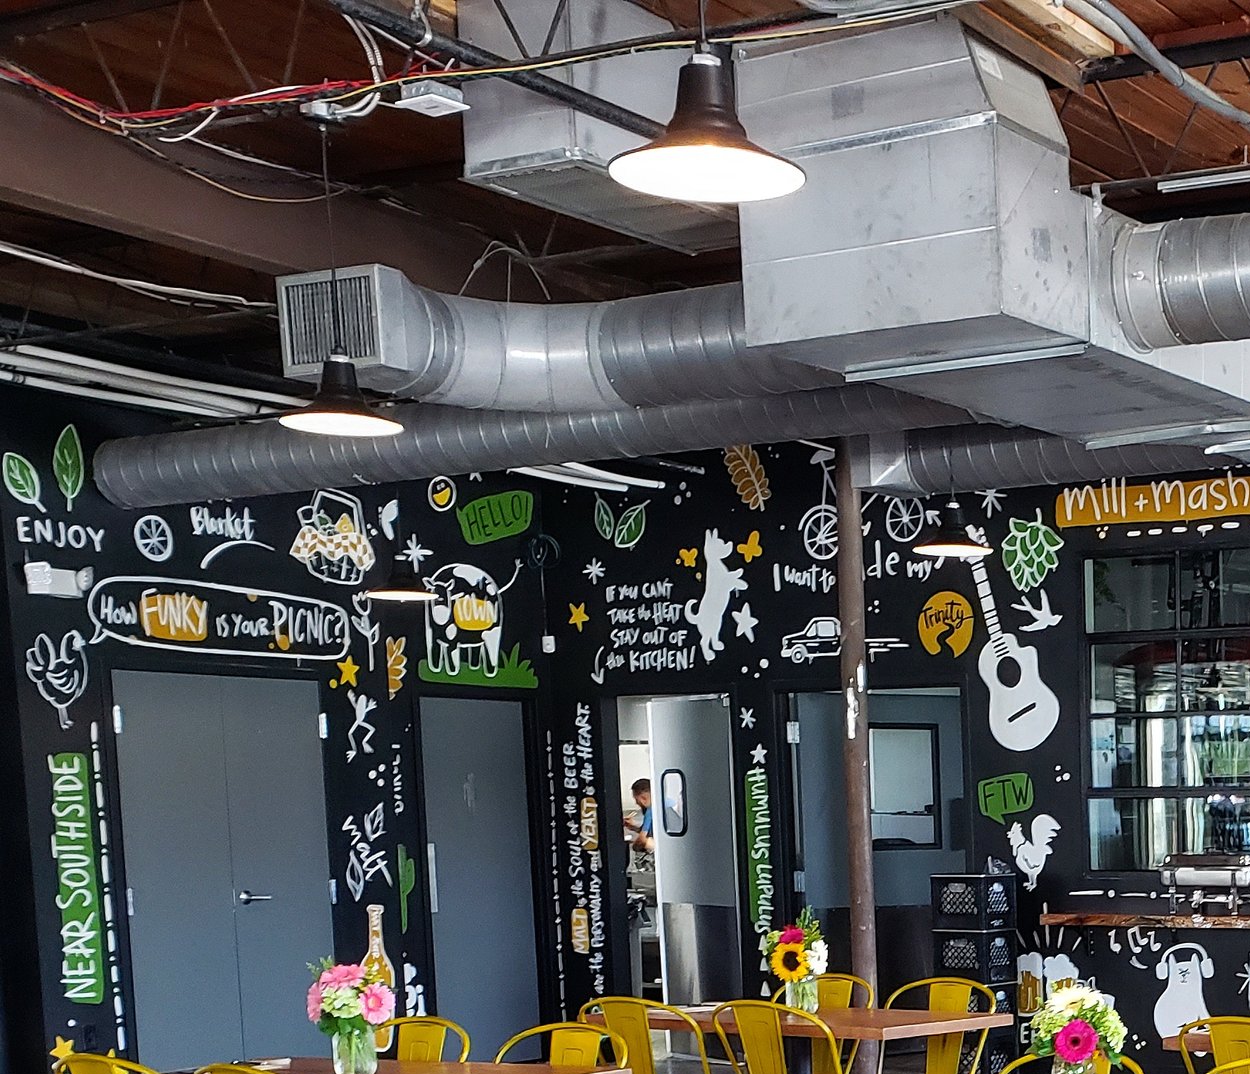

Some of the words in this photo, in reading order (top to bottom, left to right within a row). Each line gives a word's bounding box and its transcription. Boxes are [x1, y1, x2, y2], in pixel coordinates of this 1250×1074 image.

[16, 516, 105, 553] ENJOY
[190, 506, 256, 540] Blanket
[465, 495, 530, 541] HELLO!
[819, 568, 837, 593] to
[861, 540, 900, 581] de
[450, 592, 498, 623] TOWN
[618, 584, 638, 600] YOU
[141, 588, 208, 637] FUNKY
[268, 601, 343, 646] PICNIC?
[607, 608, 636, 625] TAKE
[652, 601, 683, 625] HEAT
[920, 600, 974, 630] Trinity
[610, 627, 640, 648] STAY
[642, 626, 669, 645] OUT
[669, 630, 688, 647] OF
[629, 645, 696, 672] KITCHEN!
[747, 766, 772, 860] HUMULUS
[983, 779, 1029, 813] FTW
[47, 754, 91, 910] SOUTHSIDE
[580, 801, 598, 848] YEAST
[567, 837, 586, 878] SOUL
[754, 862, 774, 934] LUPULUS
[60, 912, 97, 1000] NEAR
